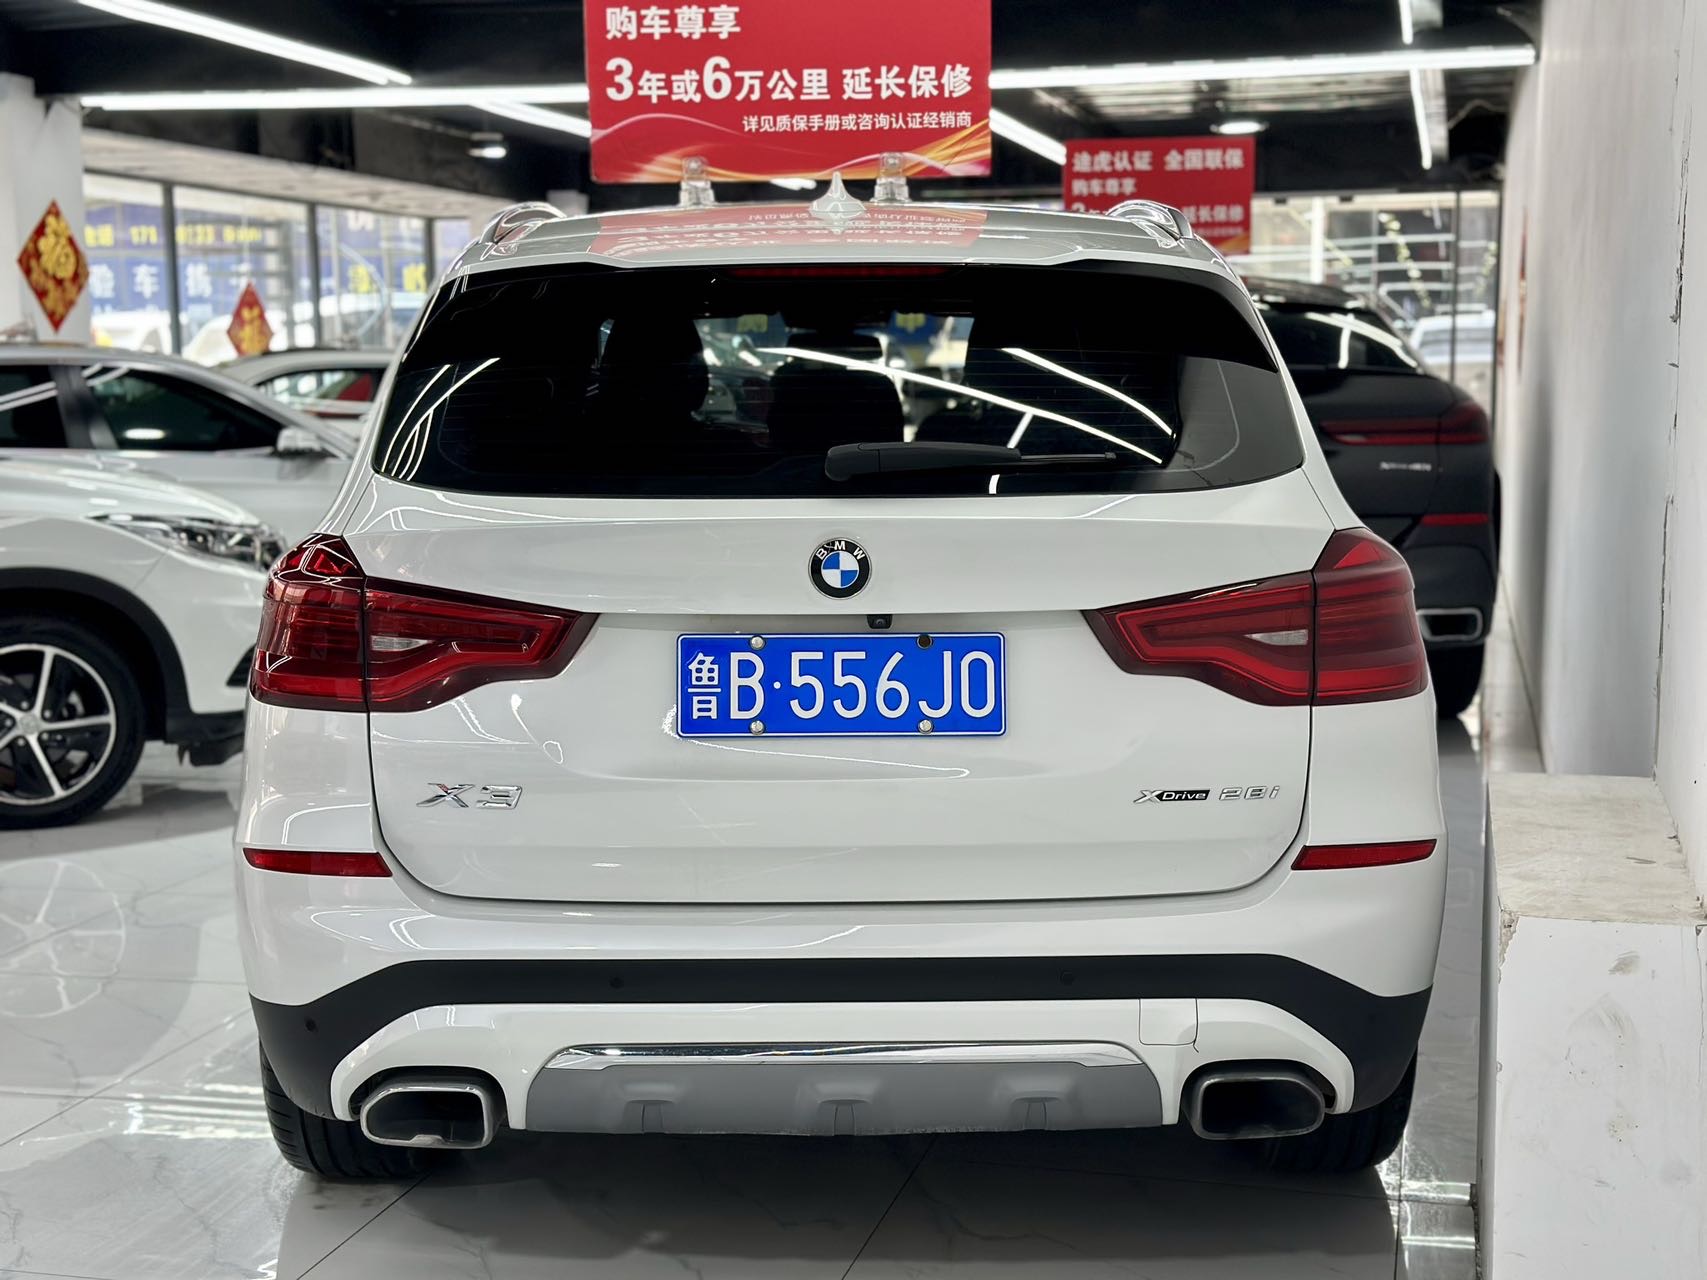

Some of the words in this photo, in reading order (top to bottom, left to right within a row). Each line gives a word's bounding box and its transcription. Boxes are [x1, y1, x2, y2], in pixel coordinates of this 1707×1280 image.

[605, 5, 741, 40] 购车尊享
[605, 56, 831, 103] 3年或6万公里
[842, 64, 973, 100] 延长保修
[743, 111, 972, 133] 详见质保手册或咨询认证经销商
[1072, 151, 1153, 173] 途虎认证
[1164, 148, 1244, 171] 全国联保
[1071, 177, 1136, 197] 购车尊享
[815, 540, 867, 561] BMW
[416, 782, 523, 810] X3
